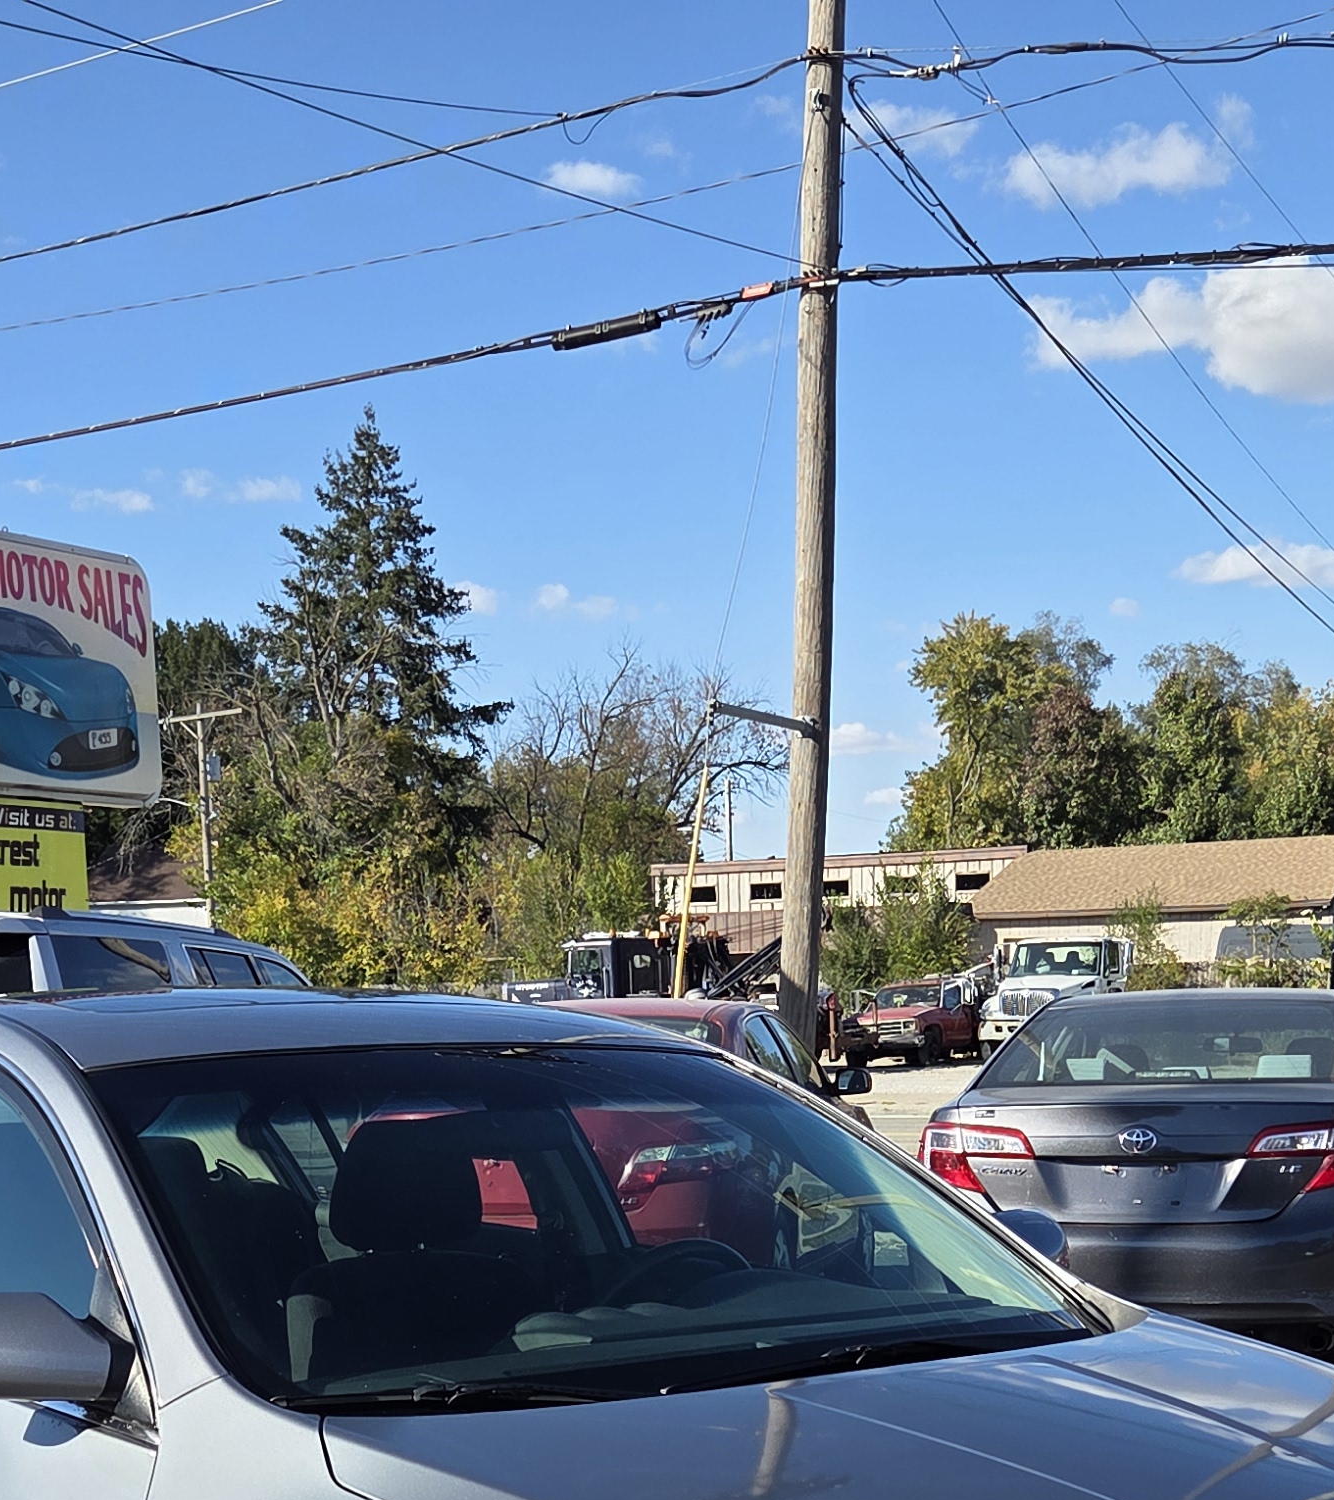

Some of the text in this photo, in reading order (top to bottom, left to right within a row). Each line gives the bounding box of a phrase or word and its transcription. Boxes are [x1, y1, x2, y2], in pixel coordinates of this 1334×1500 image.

[78, 564, 148, 658] SALES
[35, 813, 55, 828] us
[59, 812, 77, 830] at:
[10, 879, 66, 912] motor
